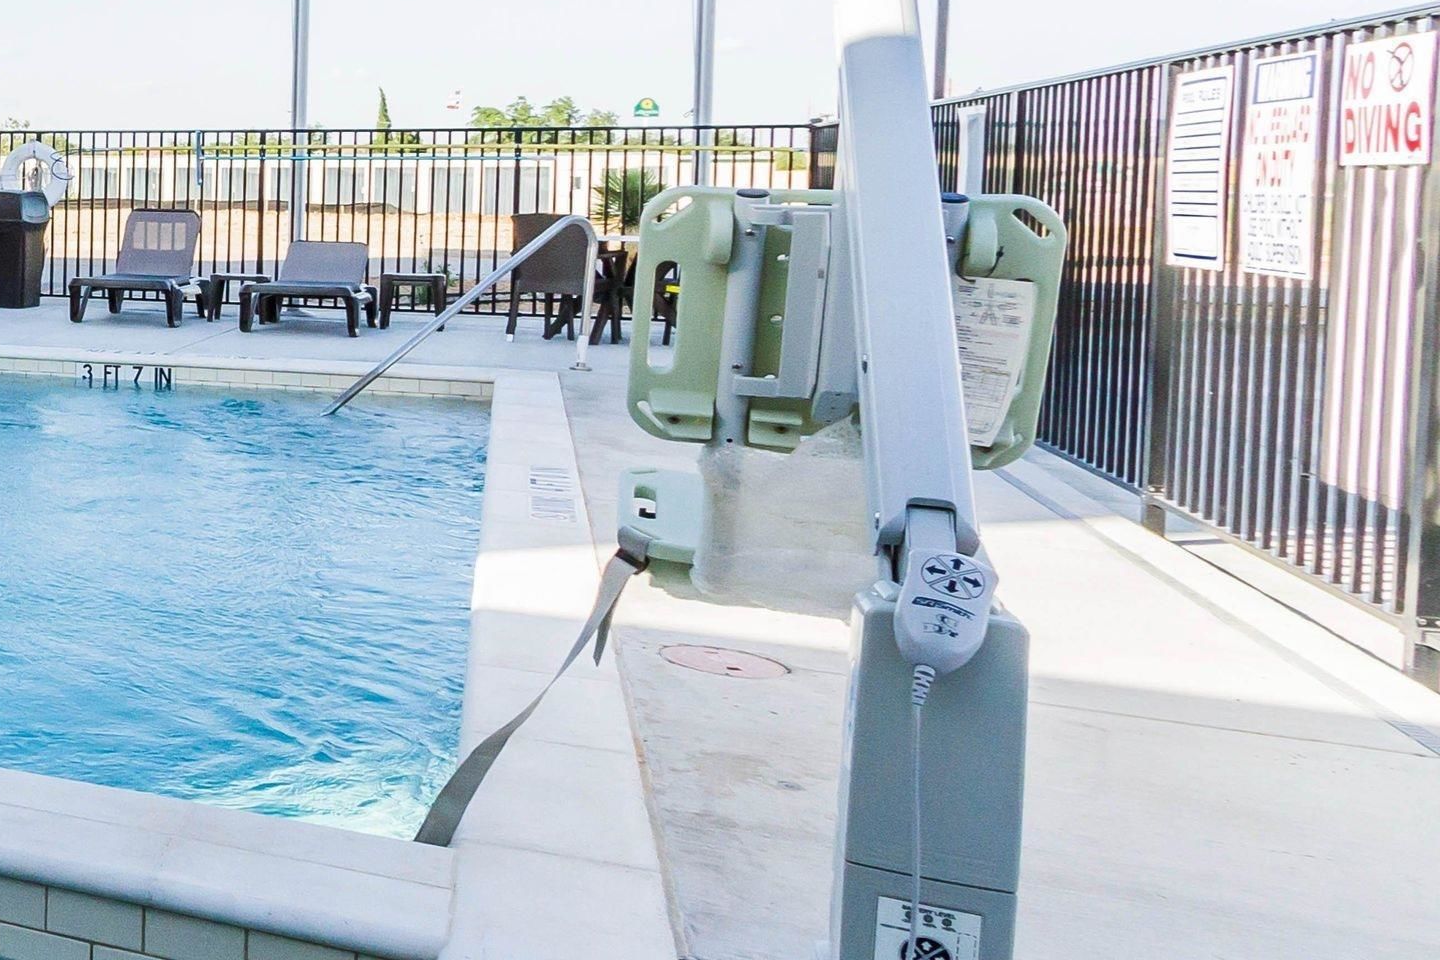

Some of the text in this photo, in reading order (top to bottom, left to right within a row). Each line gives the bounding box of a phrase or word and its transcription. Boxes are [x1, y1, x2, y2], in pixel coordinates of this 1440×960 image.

[1345, 50, 1376, 100] NO
[1344, 101, 1422, 155] DIVING
[82, 364, 172, 386] 3 FT 7 IN
